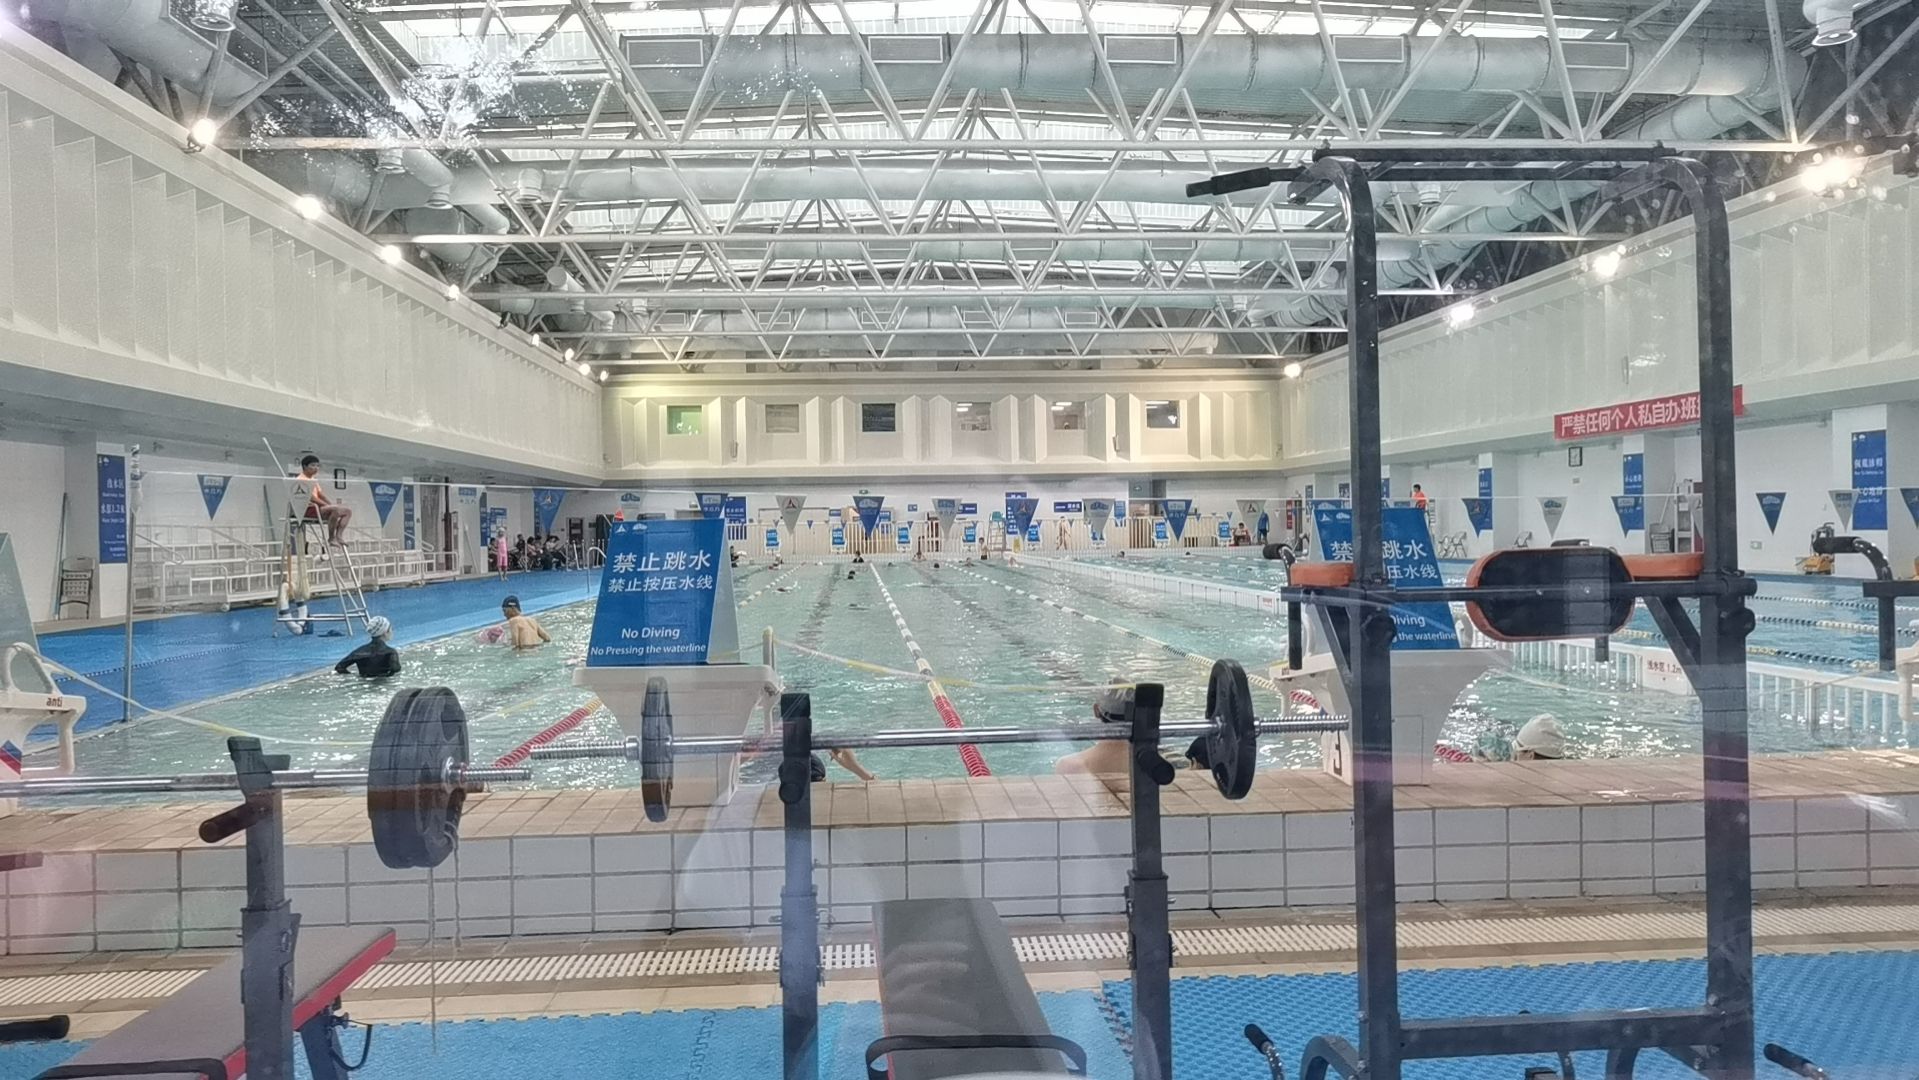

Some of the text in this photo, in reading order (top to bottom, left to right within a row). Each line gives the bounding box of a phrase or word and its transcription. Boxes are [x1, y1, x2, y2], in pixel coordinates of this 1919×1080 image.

[1561, 396, 1700, 437] 严禁任何个人私自办班
[1330, 538, 1427, 561] 禁跳水
[612, 550, 711, 573] 禁止跳水
[608, 574, 713, 593] 禁止按压水线
[621, 626, 680, 640] No Diving
[1398, 631, 1457, 641] the waterline
[590, 643, 706, 657] No Pressing the waterline
[46, 696, 63, 708] anti
